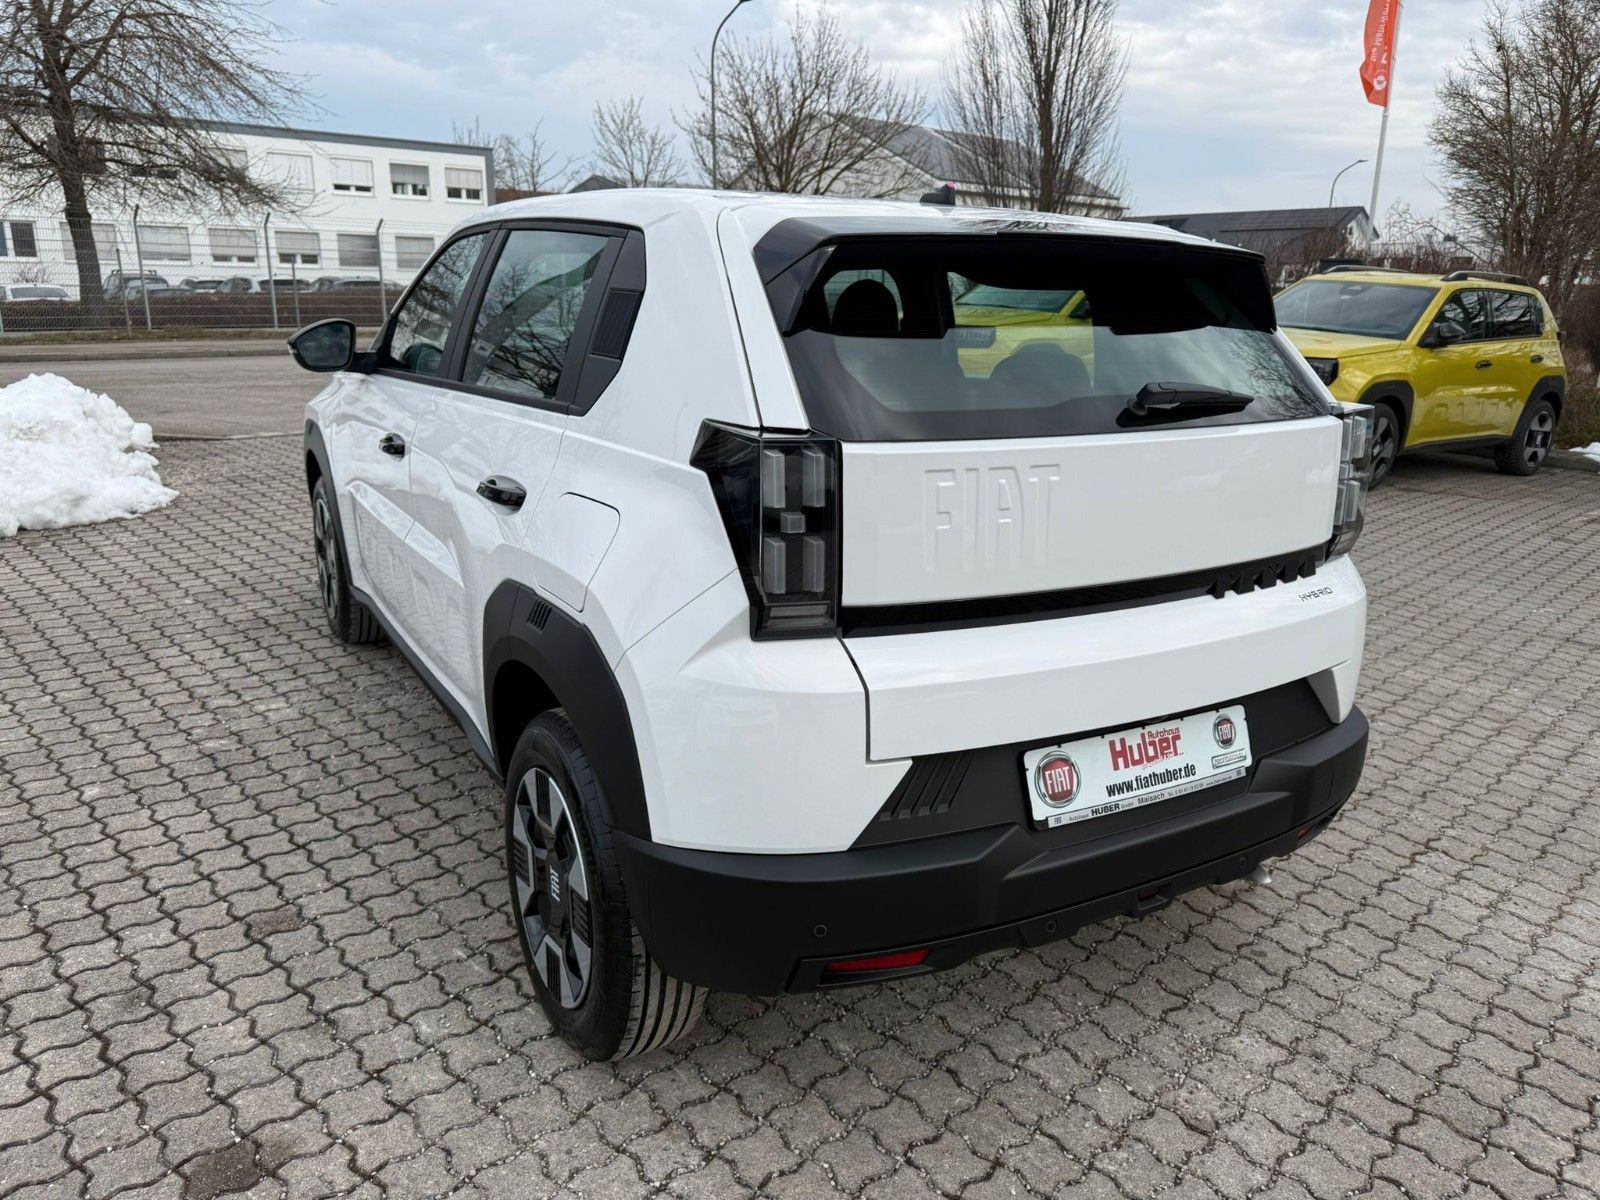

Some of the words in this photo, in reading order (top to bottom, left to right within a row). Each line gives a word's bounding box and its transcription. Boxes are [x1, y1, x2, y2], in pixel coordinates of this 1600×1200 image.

[923, 464, 1060, 571] FIAT
[1298, 587, 1333, 601] HYBRID
[1147, 727, 1180, 739] Autohaus
[1217, 723, 1232, 740] FIAT
[1108, 732, 1181, 771] Huber
[1045, 767, 1071, 795] FIAT
[1106, 763, 1196, 797] www.fiathuber.de
[1091, 803, 1120, 816] HUBER
[1138, 792, 1165, 804] Maisach
[549, 865, 560, 902] FIAT
